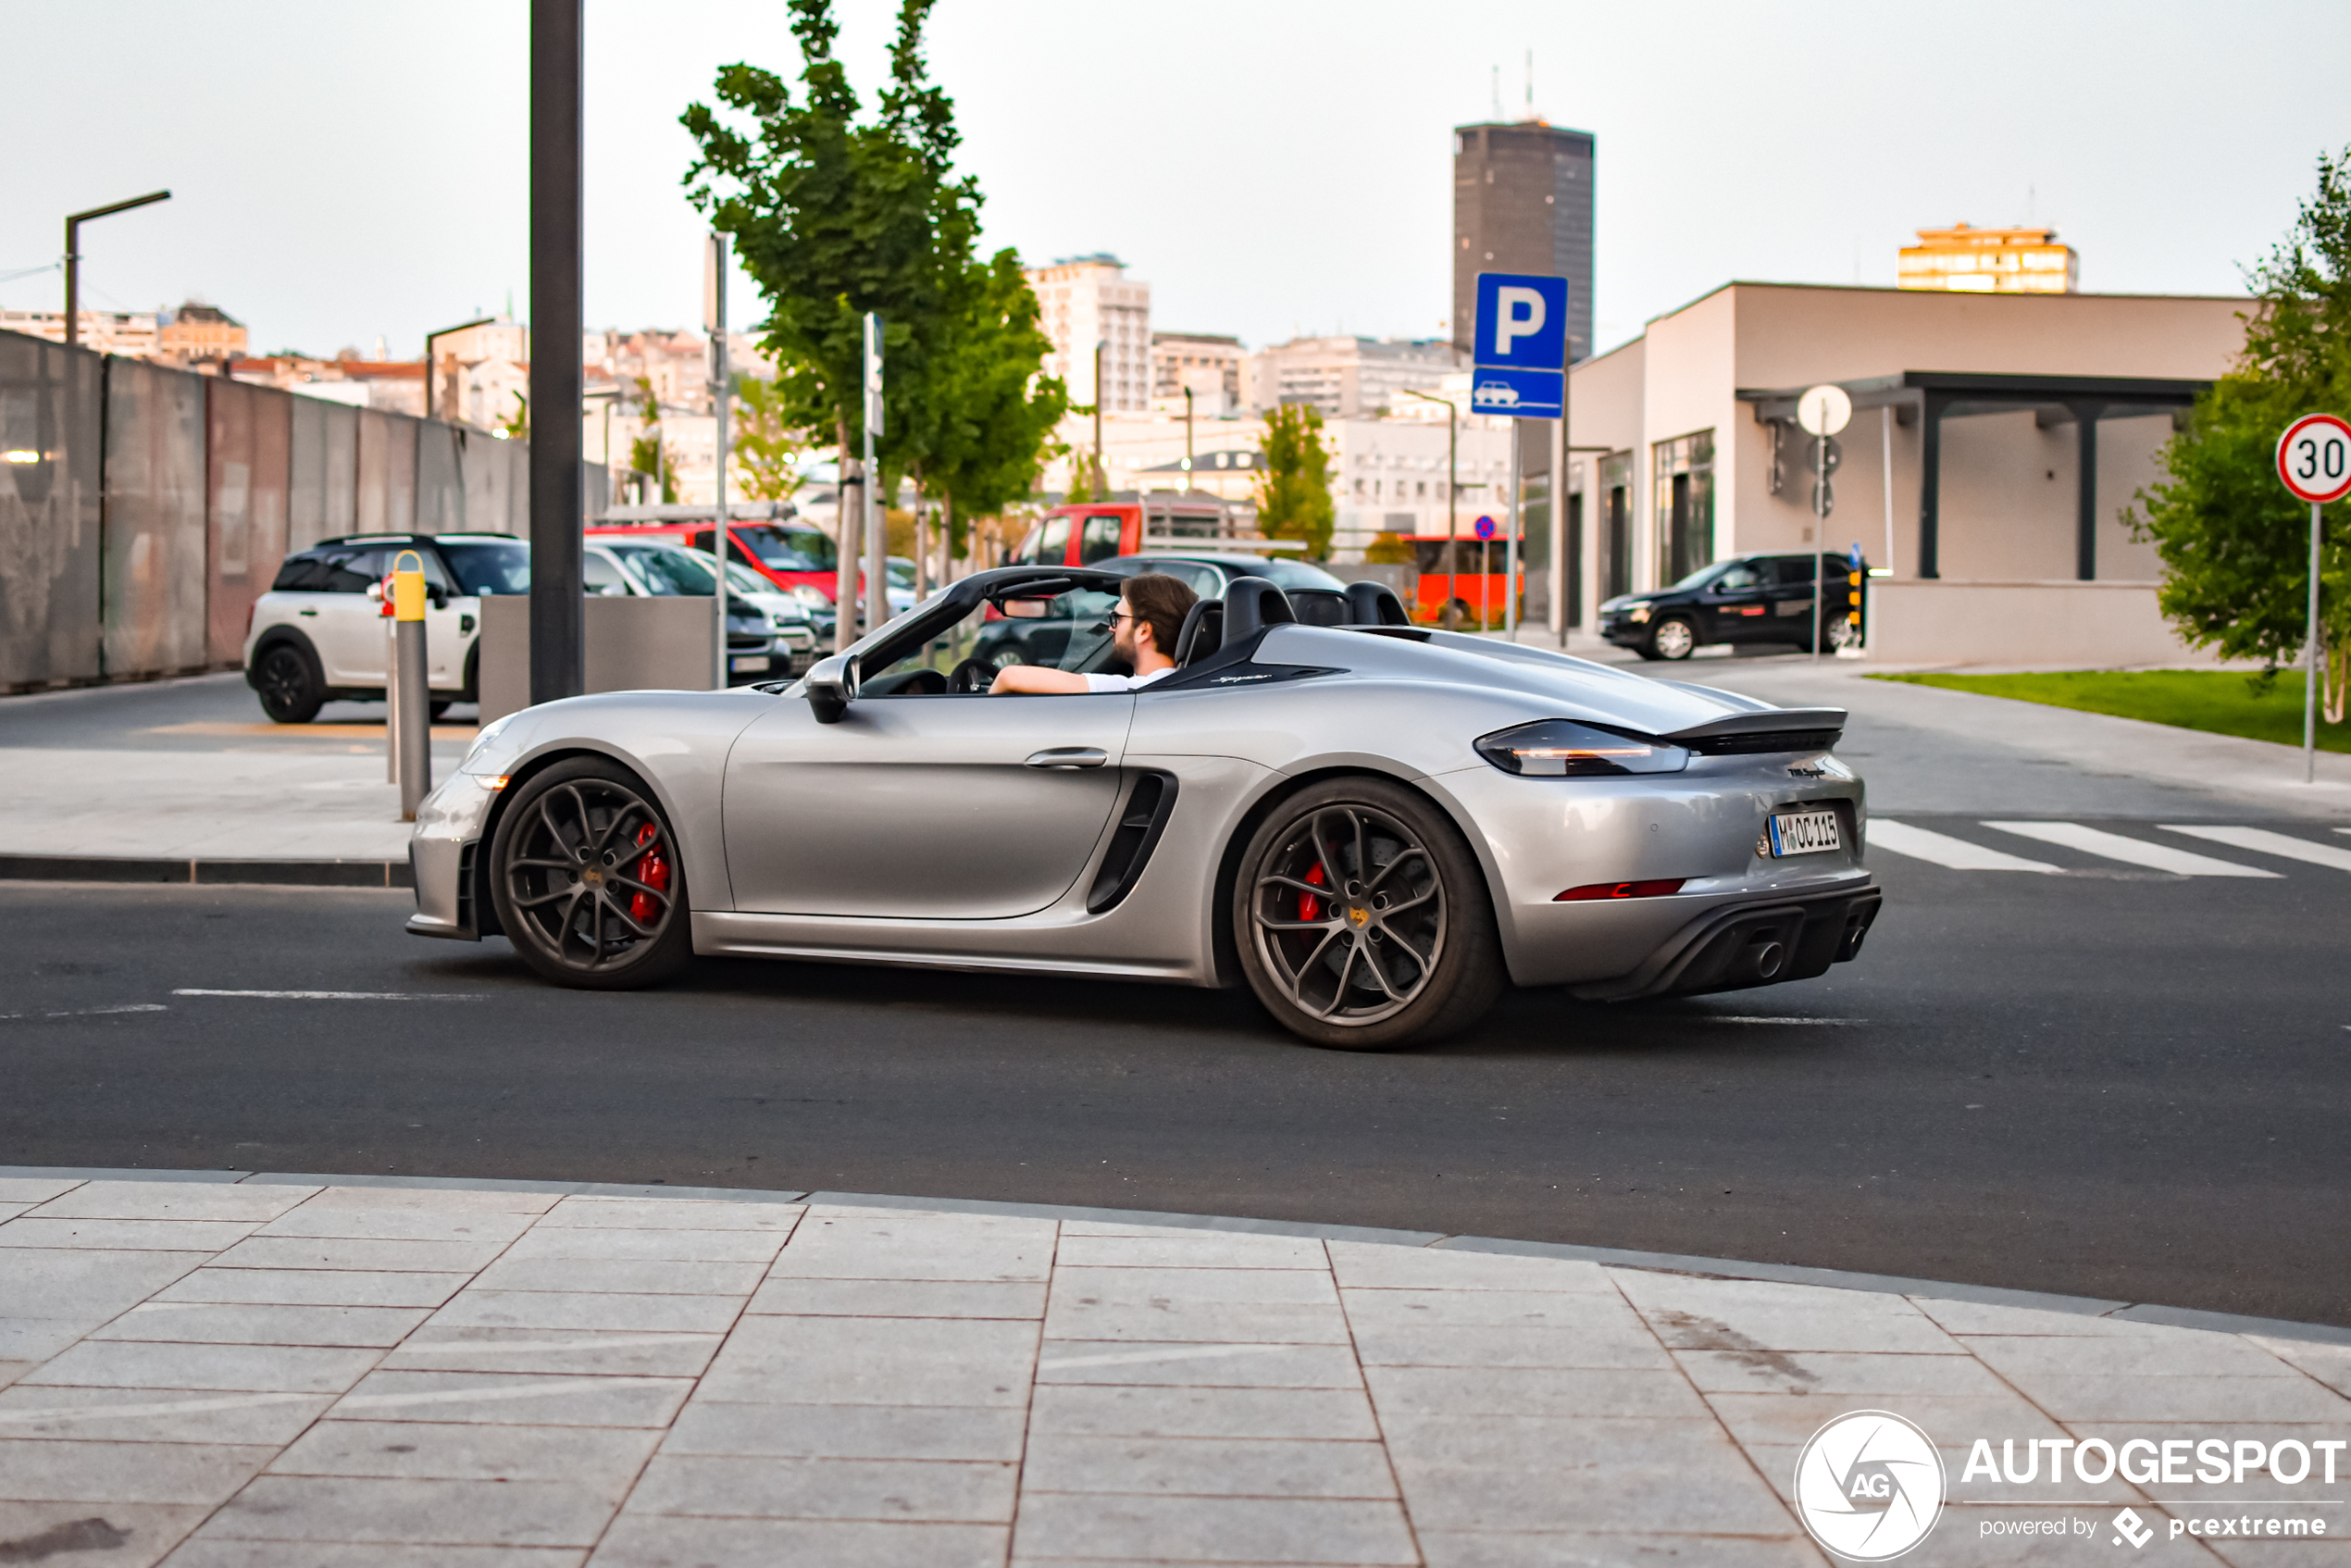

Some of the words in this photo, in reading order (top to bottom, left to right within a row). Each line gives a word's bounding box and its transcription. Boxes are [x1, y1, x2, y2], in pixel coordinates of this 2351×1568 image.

[1495, 285, 1547, 355] P
[2297, 439, 2345, 479] 30
[1778, 818, 1791, 851] M
[1796, 816, 1814, 849] OC
[1814, 815, 1837, 847] 115
